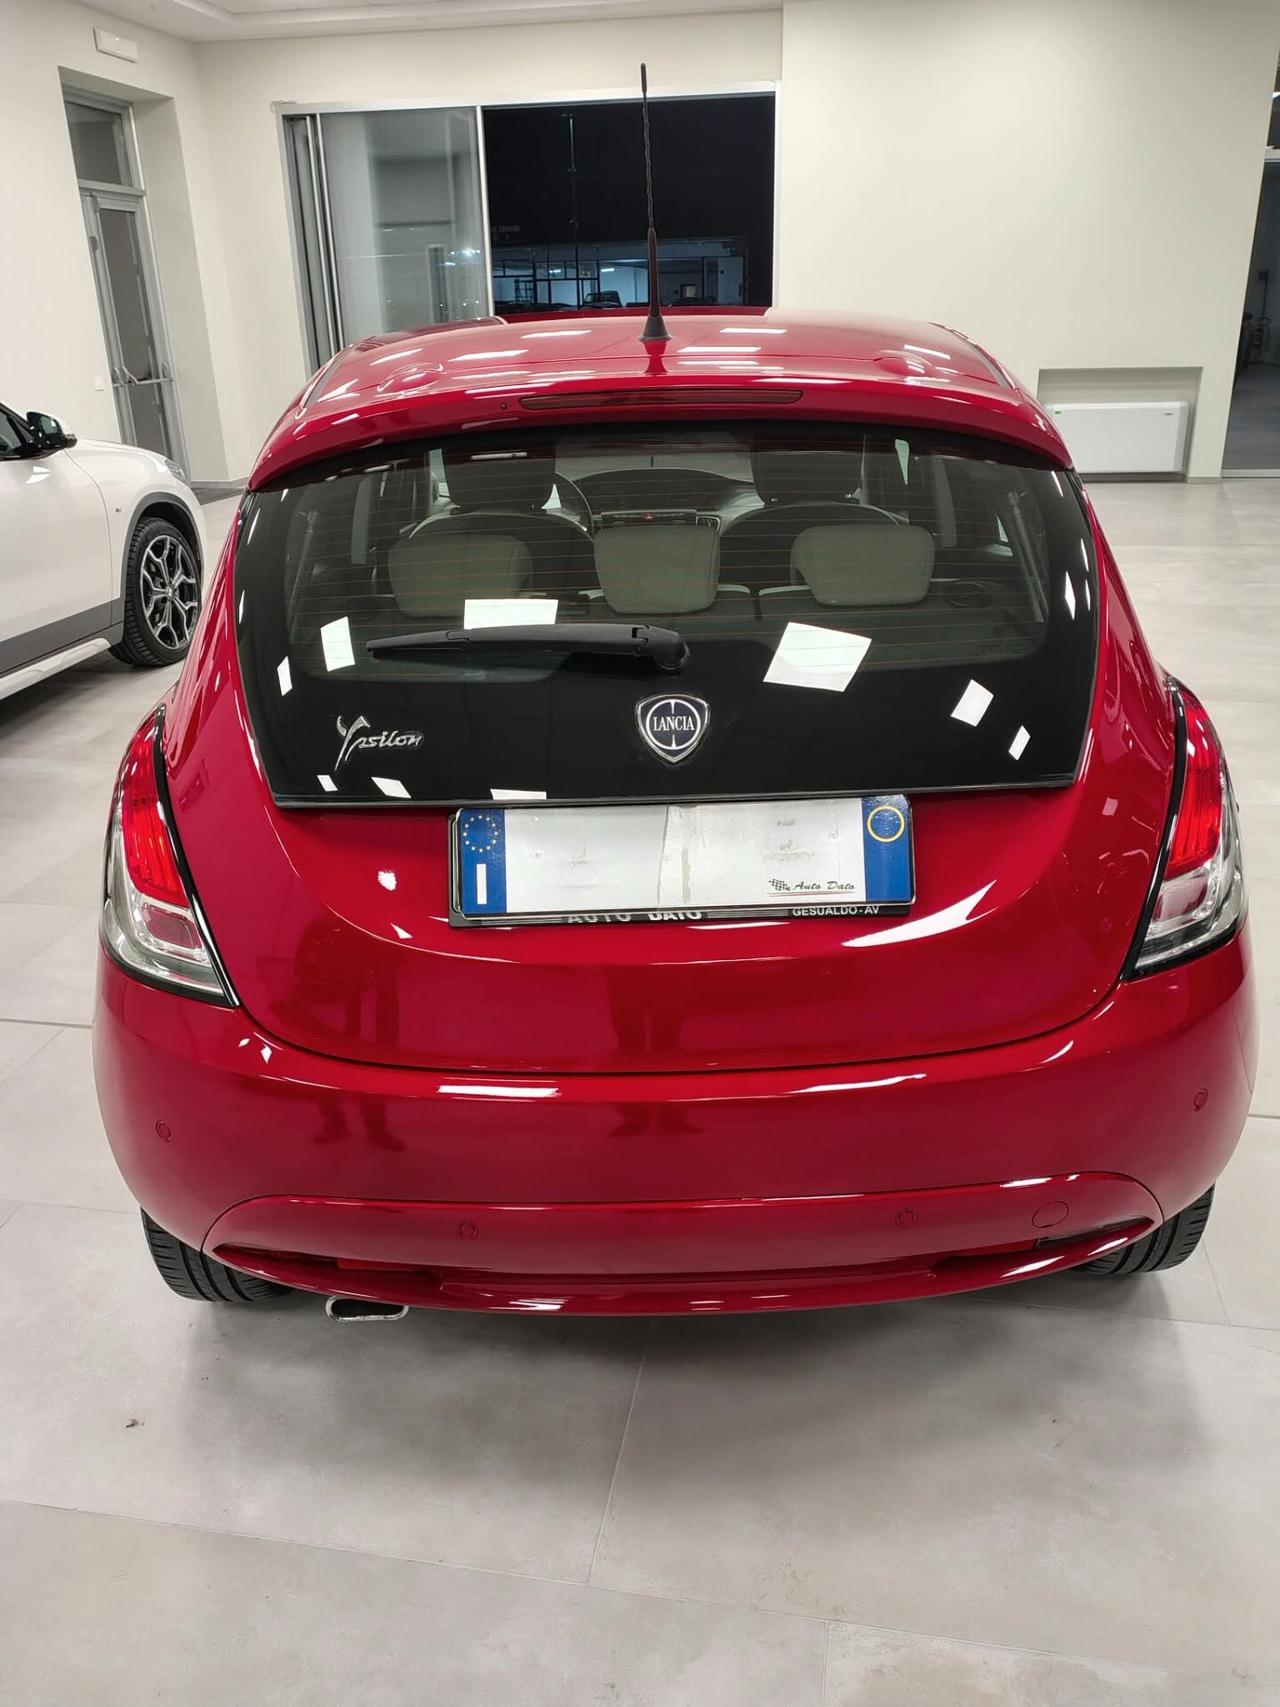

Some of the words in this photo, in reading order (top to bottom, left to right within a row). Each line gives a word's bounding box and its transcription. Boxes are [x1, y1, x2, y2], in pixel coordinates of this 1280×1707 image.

[653, 715, 695, 731] LANCIA
[336, 715, 422, 771] Ypsilon
[793, 880, 821, 891] Auto
[827, 880, 855, 890] Dato
